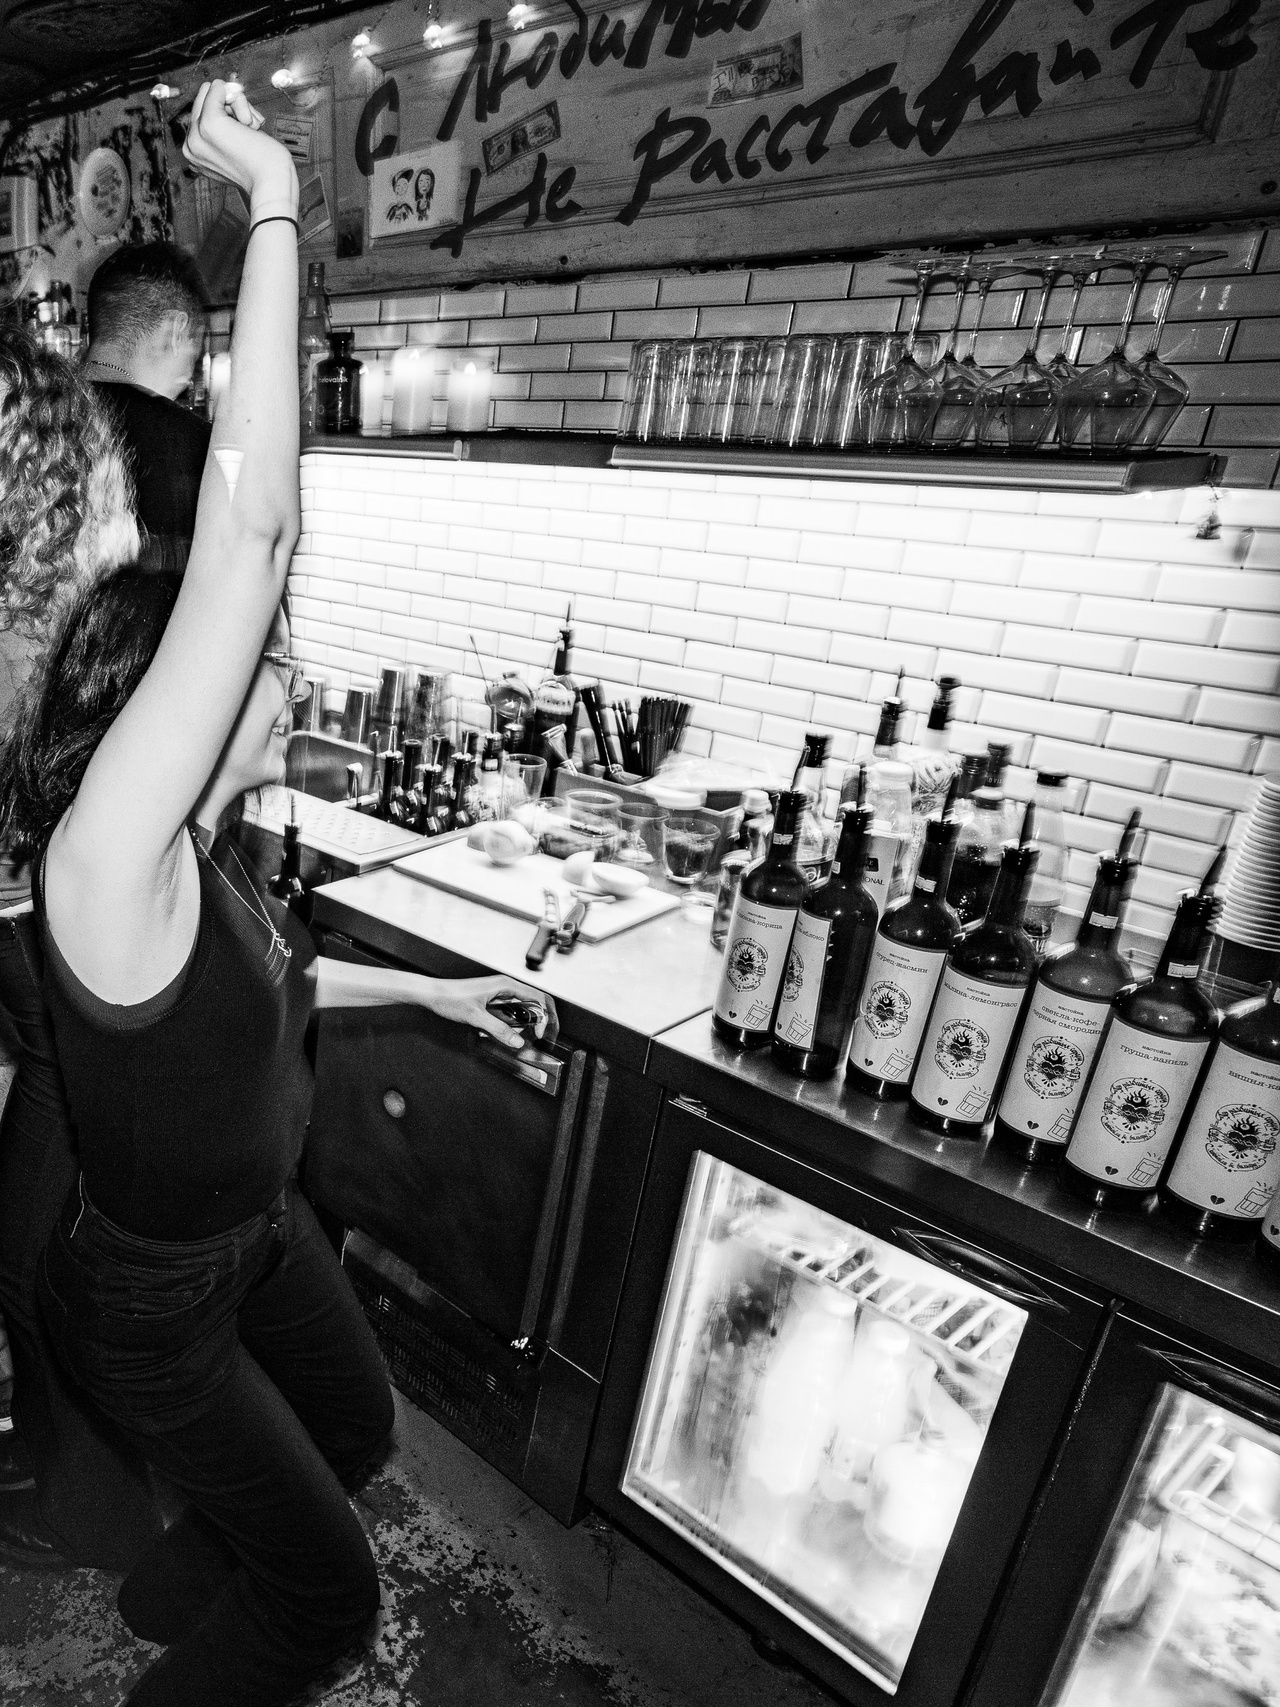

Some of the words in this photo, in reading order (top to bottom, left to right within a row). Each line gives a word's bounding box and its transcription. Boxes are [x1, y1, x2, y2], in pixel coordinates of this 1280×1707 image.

[866, 877, 885, 886] ONAL
[1058, 1021, 1102, 1035] смородин
[1120, 1044, 1189, 1067] груша-ваниль
[1142, 1045, 1171, 1056] настойка
